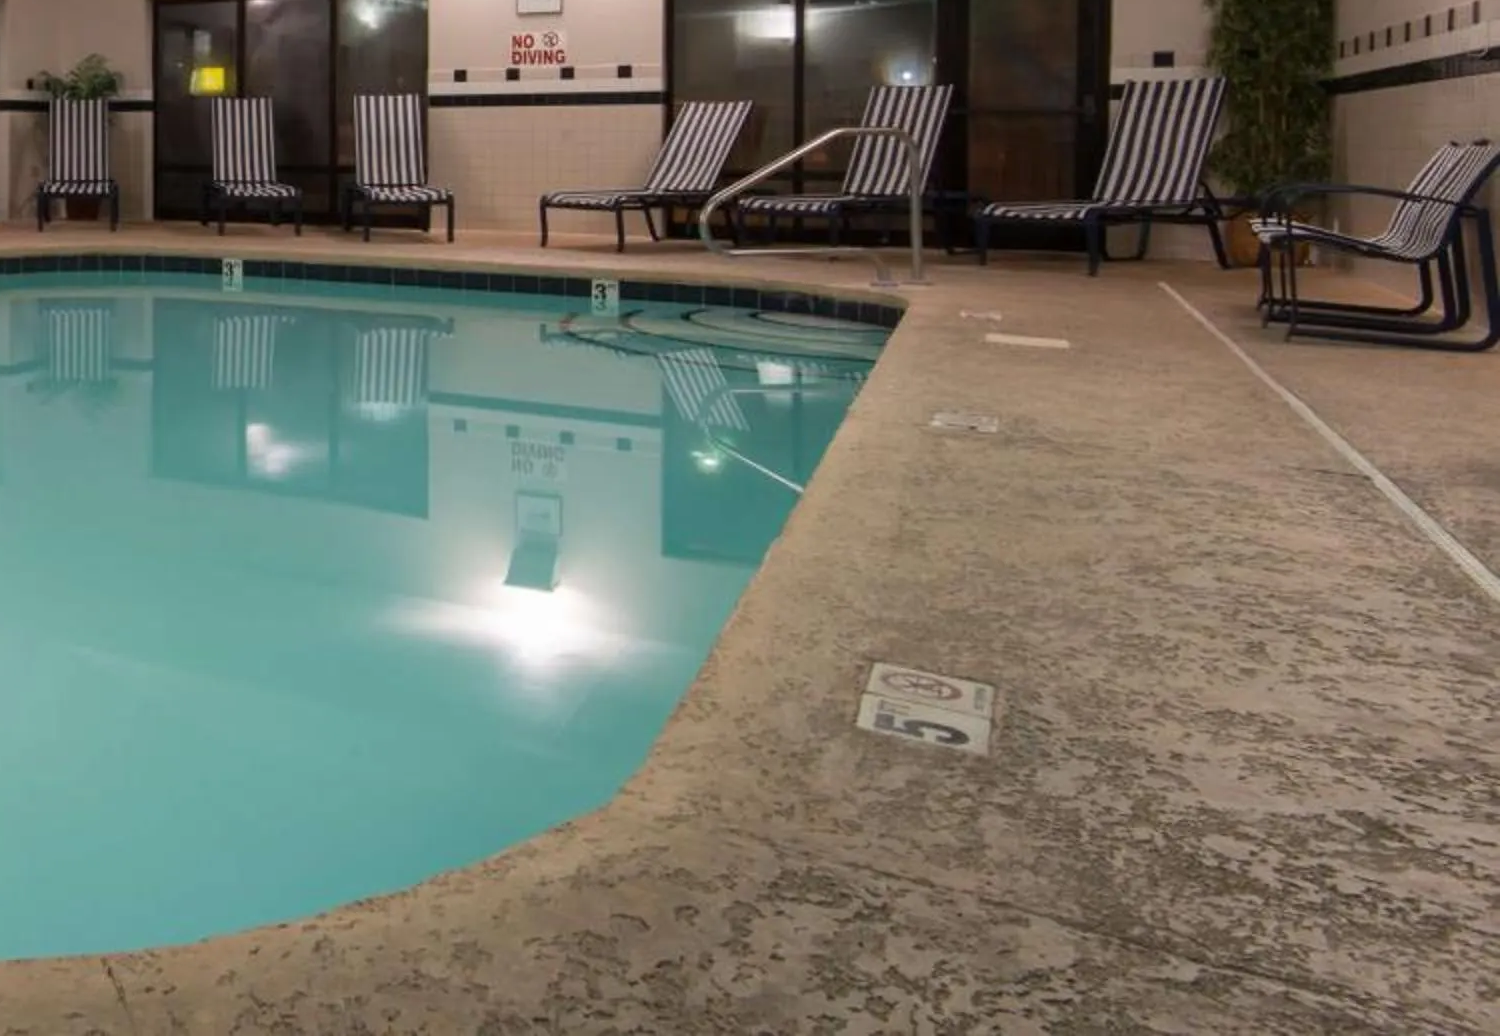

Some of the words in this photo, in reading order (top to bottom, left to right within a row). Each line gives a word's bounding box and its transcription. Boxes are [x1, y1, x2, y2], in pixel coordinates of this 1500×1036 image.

[511, 34, 535, 49] NO
[511, 50, 566, 65] DIVING
[594, 283, 607, 300] 3
[873, 712, 970, 745] 5
